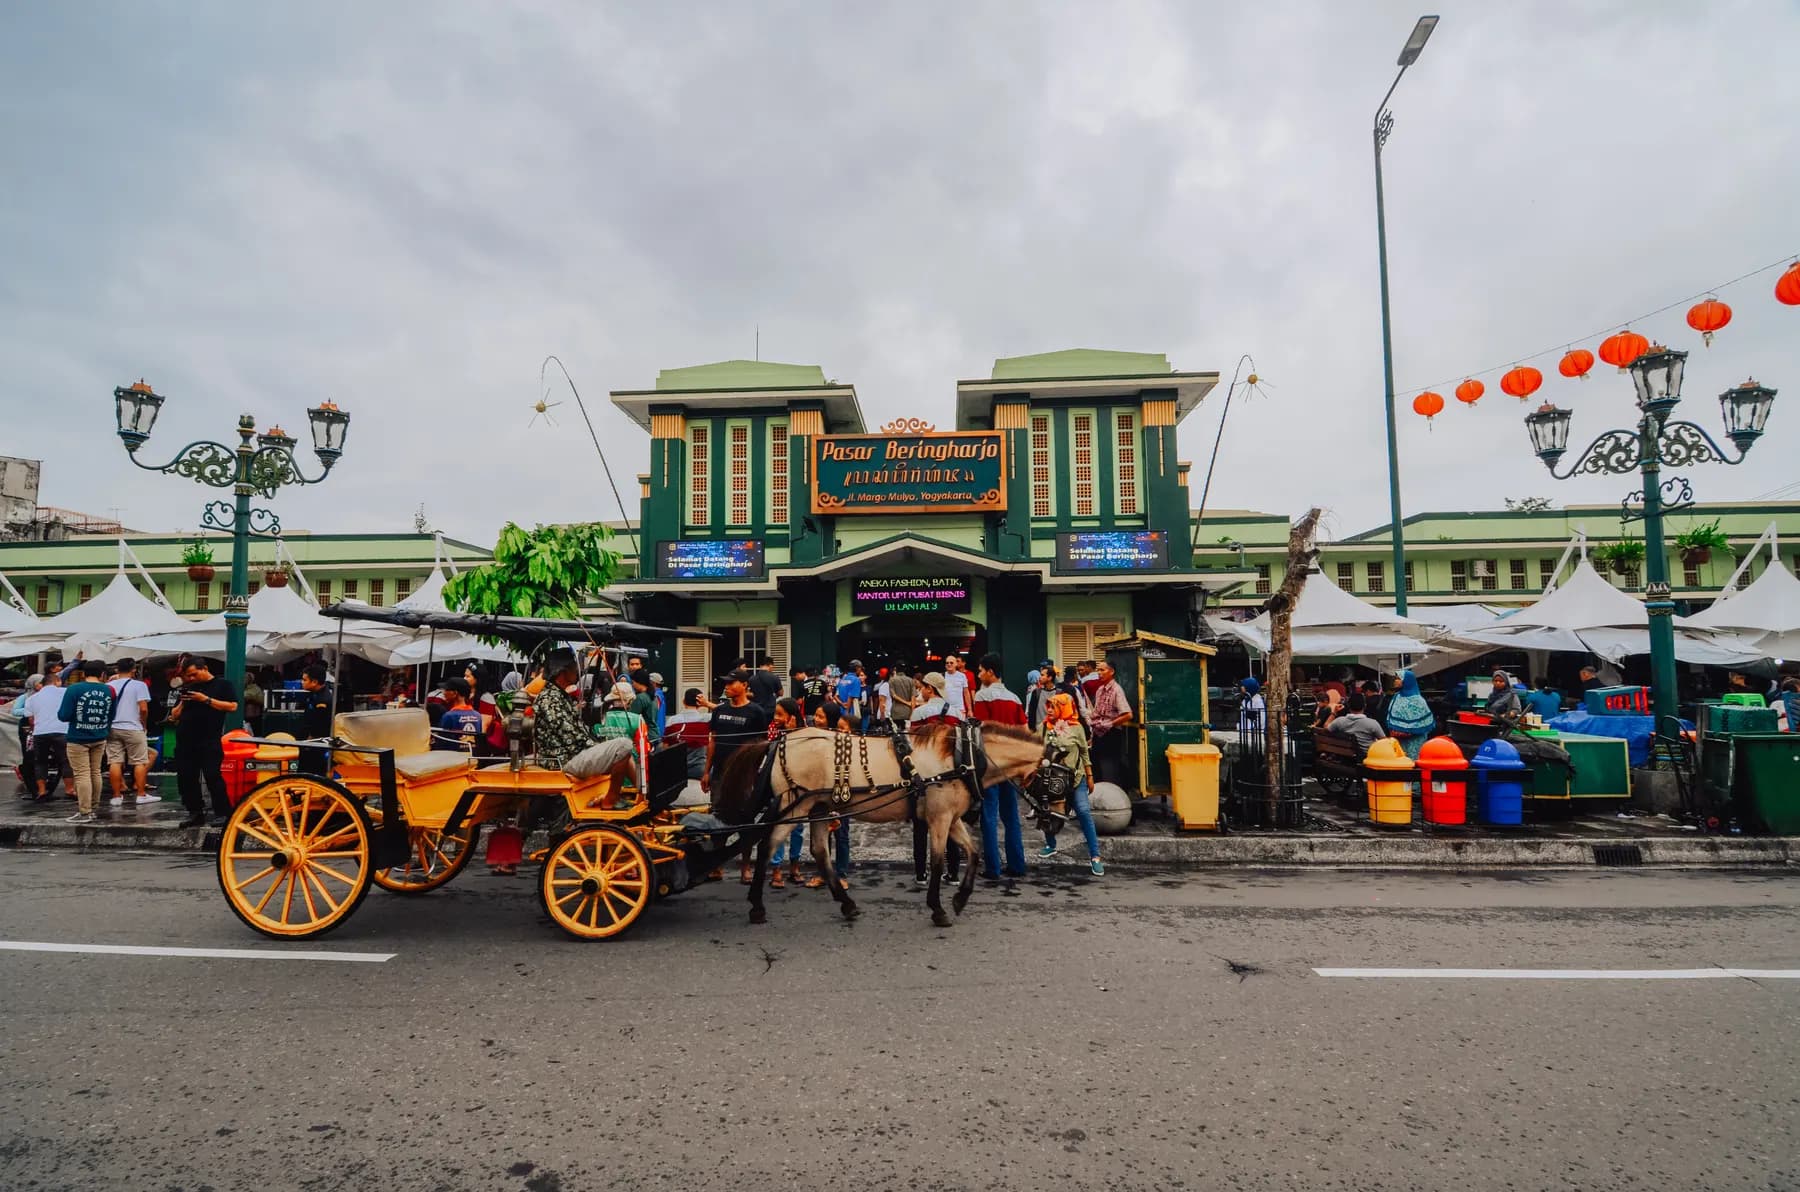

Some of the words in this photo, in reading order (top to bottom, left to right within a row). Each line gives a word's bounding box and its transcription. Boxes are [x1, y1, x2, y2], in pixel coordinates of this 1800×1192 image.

[822, 441, 877, 461] Pasar
[885, 439, 998, 461] Beringharjo
[857, 493, 886, 503] Margo
[920, 491, 972, 503] Yogyakarta
[703, 560, 753, 568] Beringharjo
[859, 579, 889, 588] ANEKA
[890, 578, 931, 588] FASHION,
[932, 578, 962, 587] BATIK,
[857, 592, 890, 600] KANTOR
[891, 591, 907, 600] UPT
[908, 591, 934, 599] PUSAT
[935, 590, 966, 599] BISNIS
[885, 602, 896, 611] DI
[897, 602, 930, 611] LANTAI
